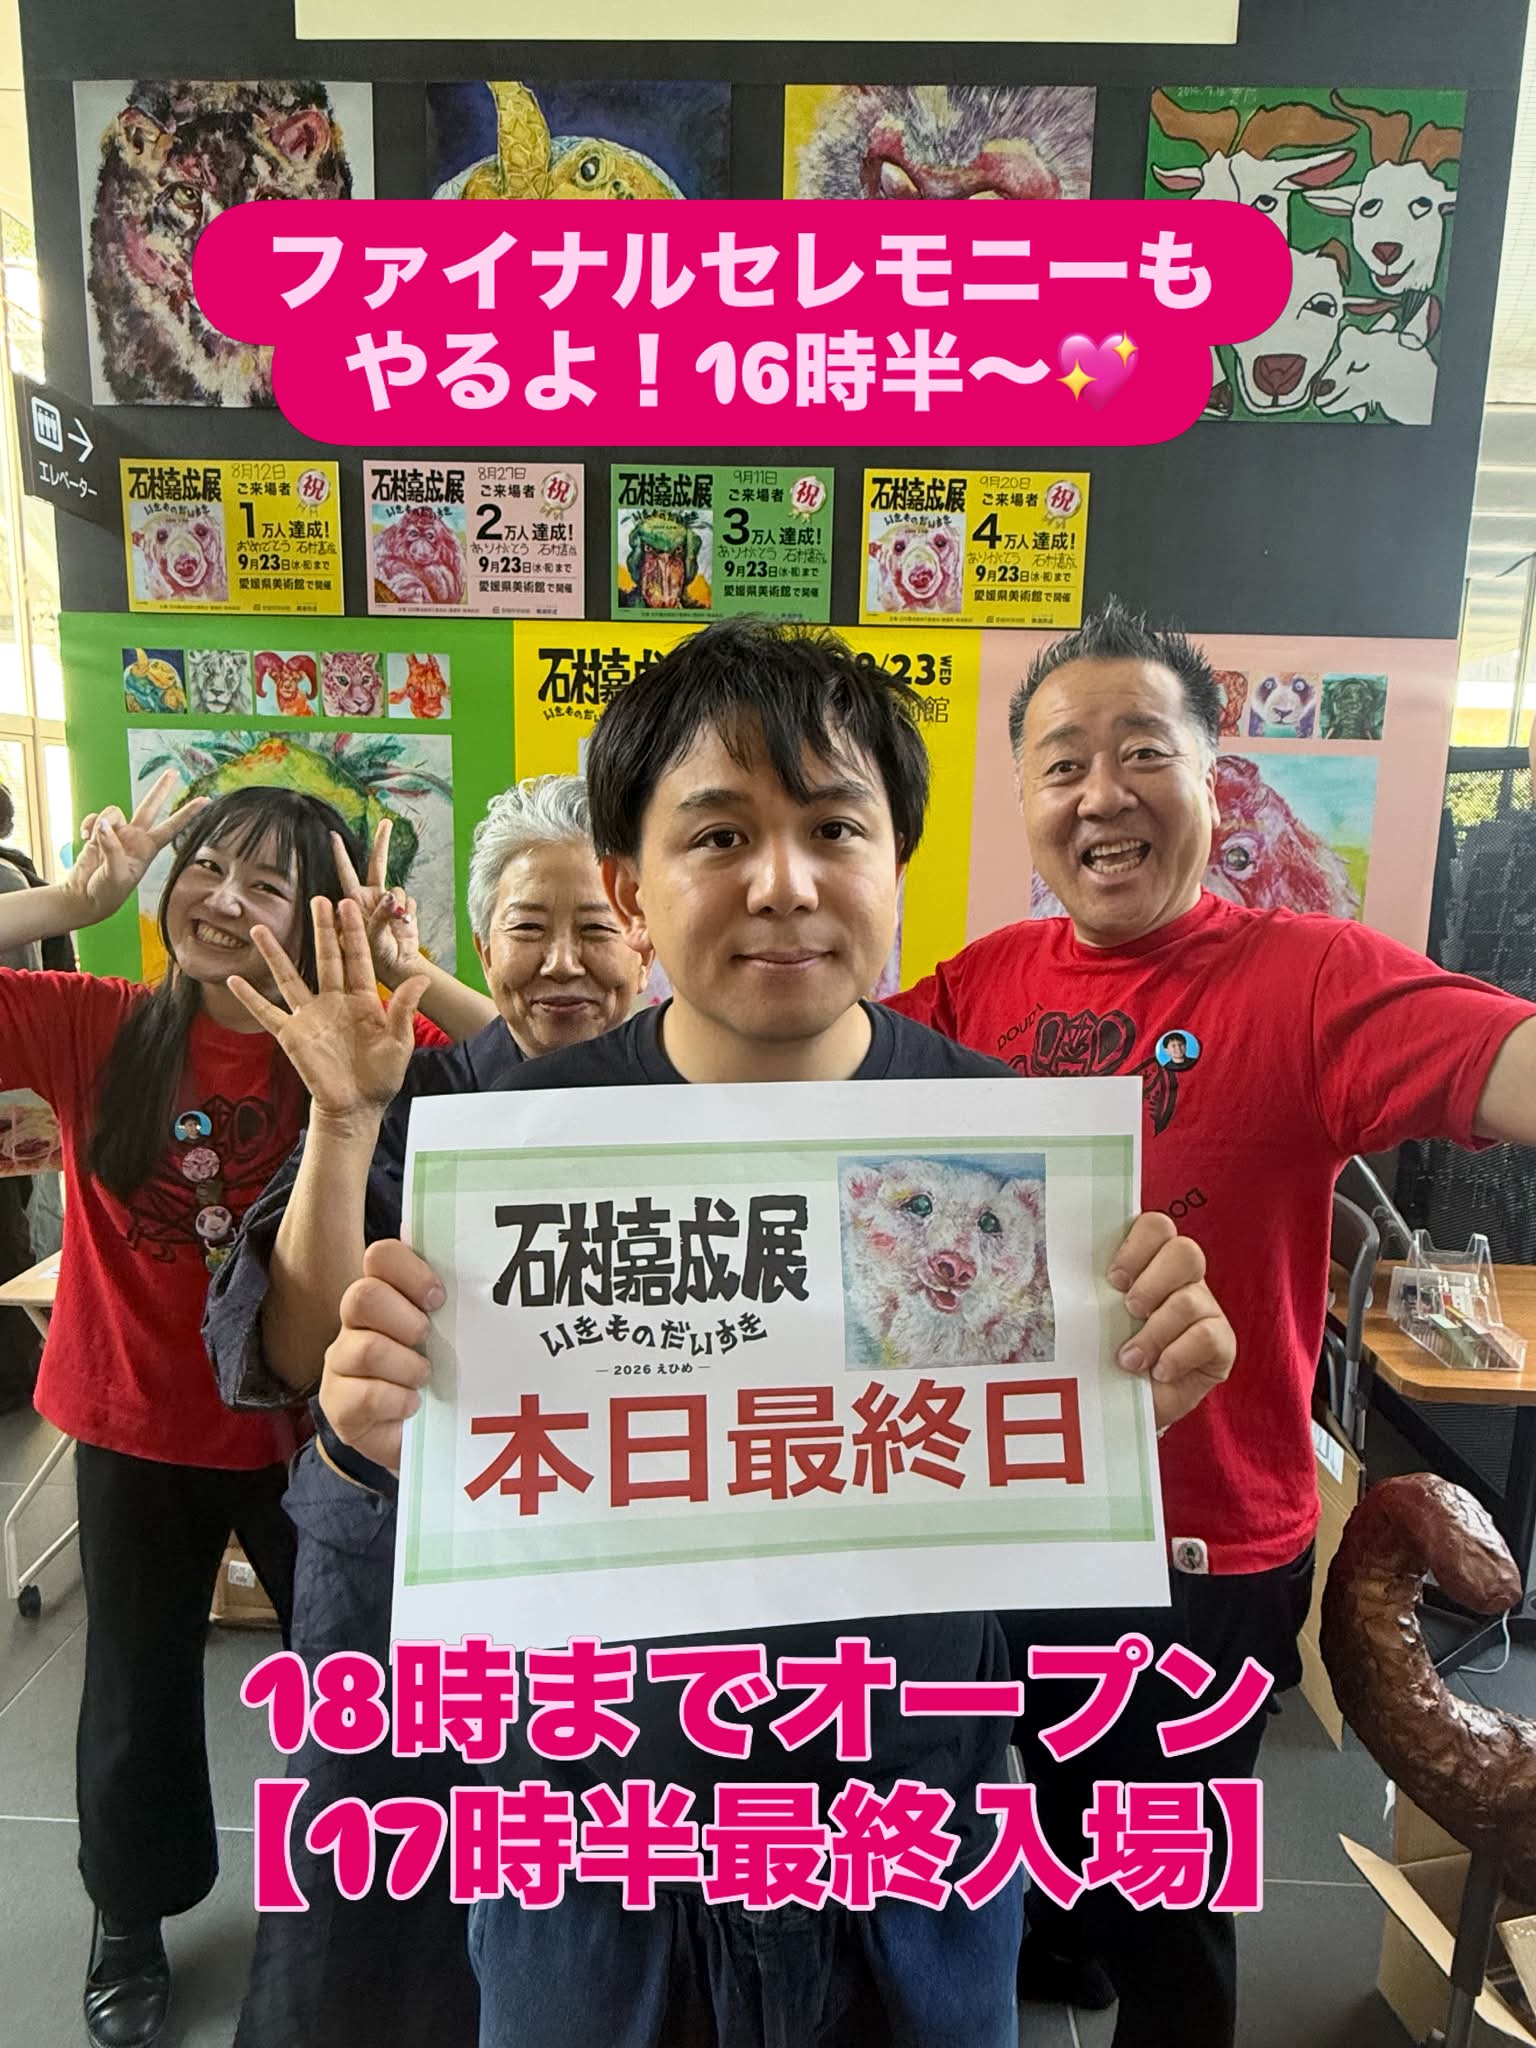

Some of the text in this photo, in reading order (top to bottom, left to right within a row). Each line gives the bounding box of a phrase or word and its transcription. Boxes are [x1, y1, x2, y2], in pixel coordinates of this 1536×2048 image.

[39, 461, 97, 498] エレベーター
[231, 464, 287, 481] 8月12日
[478, 467, 526, 480] 8月27日
[733, 471, 777, 485] 9月11日
[979, 476, 1031, 490] 9月20日
[127, 466, 222, 502] 石村嘉成展
[237, 482, 291, 496] ご来場者
[303, 473, 325, 500] 祝
[371, 469, 465, 504] 石村嘉成展
[480, 484, 535, 498] ご来場者
[547, 477, 570, 502] 祝
[618, 472, 713, 508] 石村嘉成展
[796, 481, 820, 507] 祝
[870, 477, 967, 512] 石村嘉成展
[728, 488, 784, 502] ご来場者
[982, 493, 1038, 507] ご来場者
[1050, 485, 1076, 513] 祝
[239, 578, 332, 591] 愛媛県美術館で開催
[479, 581, 573, 593] 愛媛県美術館で開催
[724, 585, 819, 597] 愛媛県美術館で開催
[974, 590, 1071, 602] 愛媛県美術館で開催
[939, 655, 952, 685] WED
[492, 1194, 810, 1307] 石村嘉成展
[539, 1311, 769, 1357] いきものだいすき
[613, 1362, 693, 1376] 2026 えひめ
[464, 1377, 1085, 1516] 本日最終日
